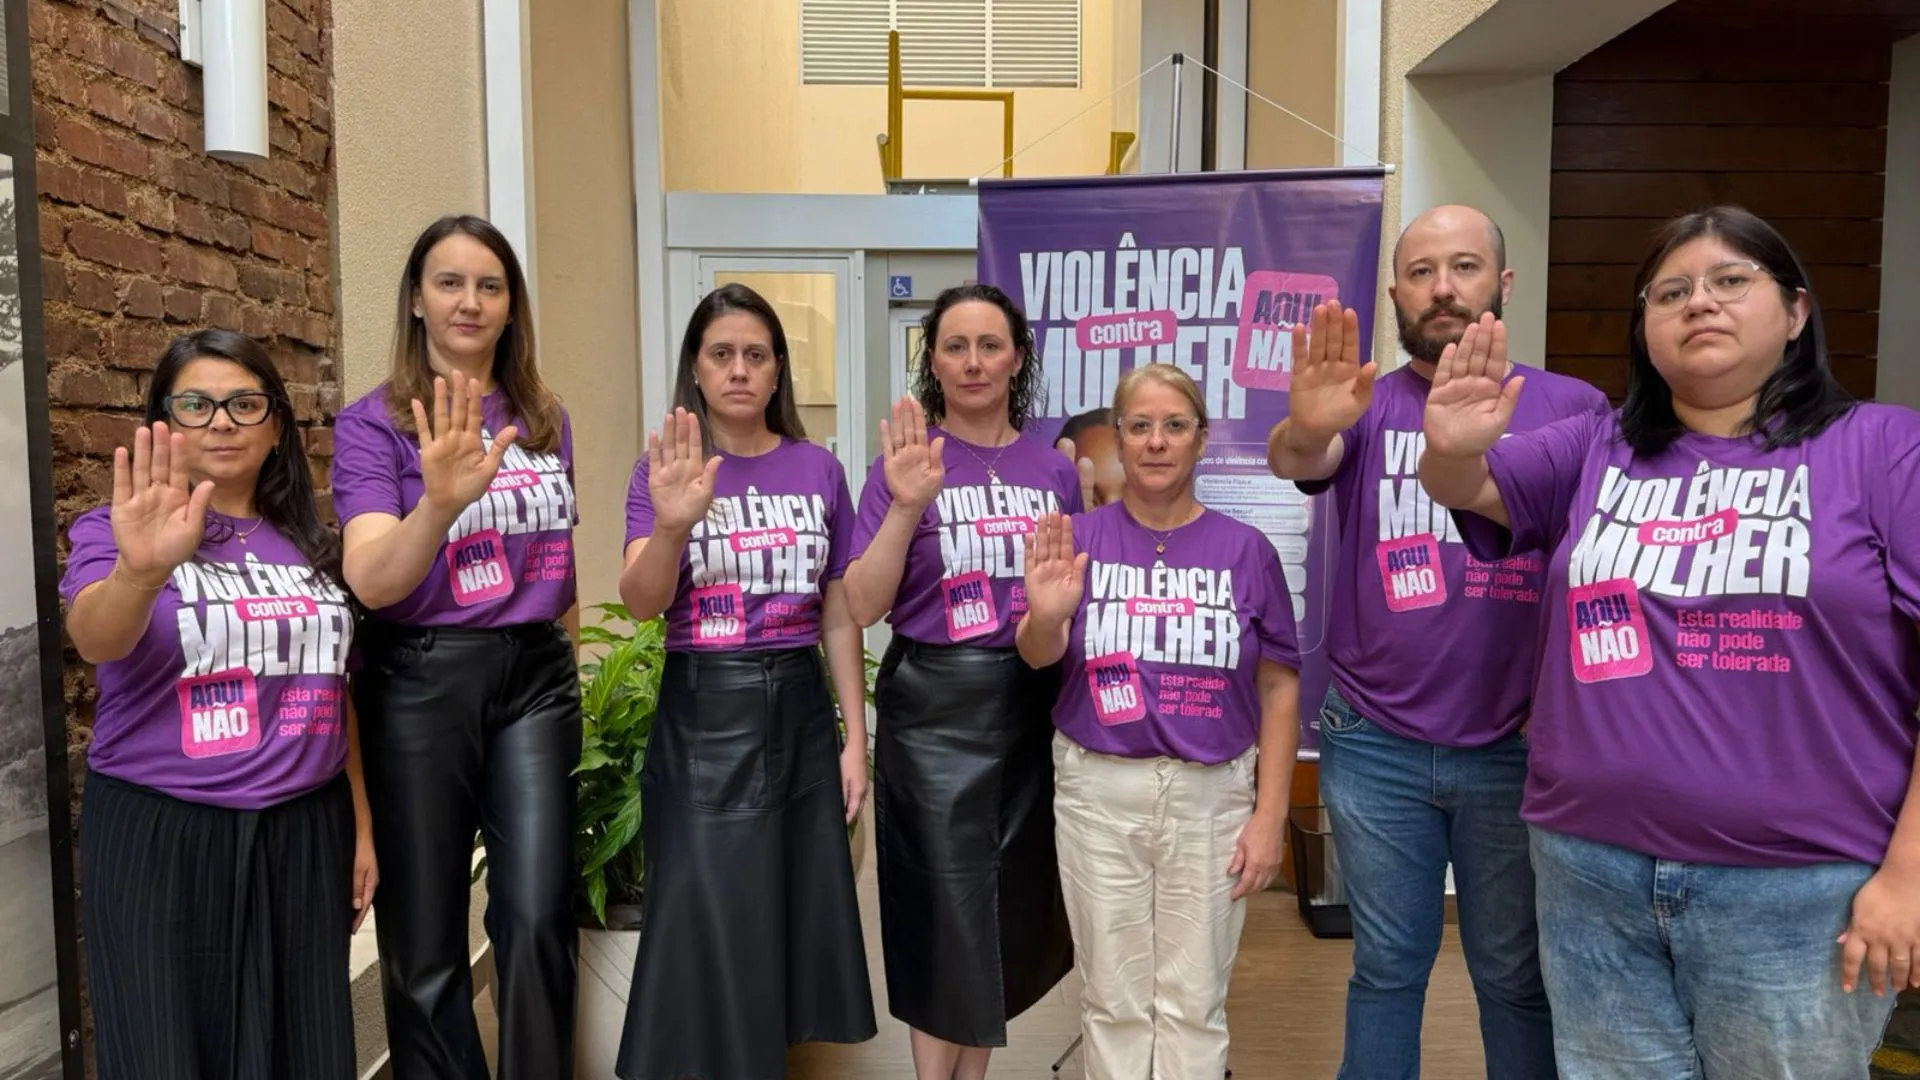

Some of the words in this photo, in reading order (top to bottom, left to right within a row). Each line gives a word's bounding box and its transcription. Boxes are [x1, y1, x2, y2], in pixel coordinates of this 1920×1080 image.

[1019, 232, 1246, 321] VIOLÊNCIA
[1089, 317, 1163, 345] contra
[1247, 320, 1306, 372] NÃ
[1033, 325, 1246, 419] MULER
[491, 473, 533, 489] contra
[1596, 459, 1812, 524] VIOLÊNCIA
[983, 520, 1028, 534] contra
[1652, 517, 1725, 543] contra
[739, 532, 788, 549] contra
[455, 540, 496, 569] AQUI
[1387, 545, 1431, 572] AQUI
[1568, 513, 1811, 598] MULHER
[457, 560, 504, 594] NÃO
[1091, 560, 1237, 611] VIOLÊNCIA
[1391, 564, 1437, 600] NÃO
[1465, 568, 1489, 583] não
[1494, 571, 1524, 587] pode
[700, 594, 735, 617] AQUI
[950, 580, 984, 606] AQUI
[1464, 586, 1487, 598] ser
[1489, 584, 1540, 603] tolerada
[246, 600, 308, 617] contra
[764, 602, 789, 616] Esta
[952, 600, 989, 630] NÃO
[1135, 601, 1185, 614] contra
[1575, 592, 1631, 629] AQUI
[1676, 609, 1715, 628] Esta
[1719, 610, 1804, 629] realidade
[700, 612, 740, 638] NÃO
[1085, 602, 1241, 670] MULHER
[1579, 620, 1639, 666] NÃO
[1676, 629, 1711, 647] não
[1719, 631, 1765, 651] pode
[1095, 663, 1131, 687] AQUI
[1676, 653, 1708, 669] ser
[1711, 651, 1792, 673] tolerada
[1160, 673, 1184, 687] Esta
[191, 679, 243, 710] AQUI
[1100, 682, 1137, 714] NÃO
[1160, 686, 1180, 701] não
[1183, 690, 1212, 705] pode
[280, 703, 307, 719] não
[1159, 703, 1178, 715] ser
[192, 702, 249, 743] NÃO
[280, 722, 306, 737] ser
